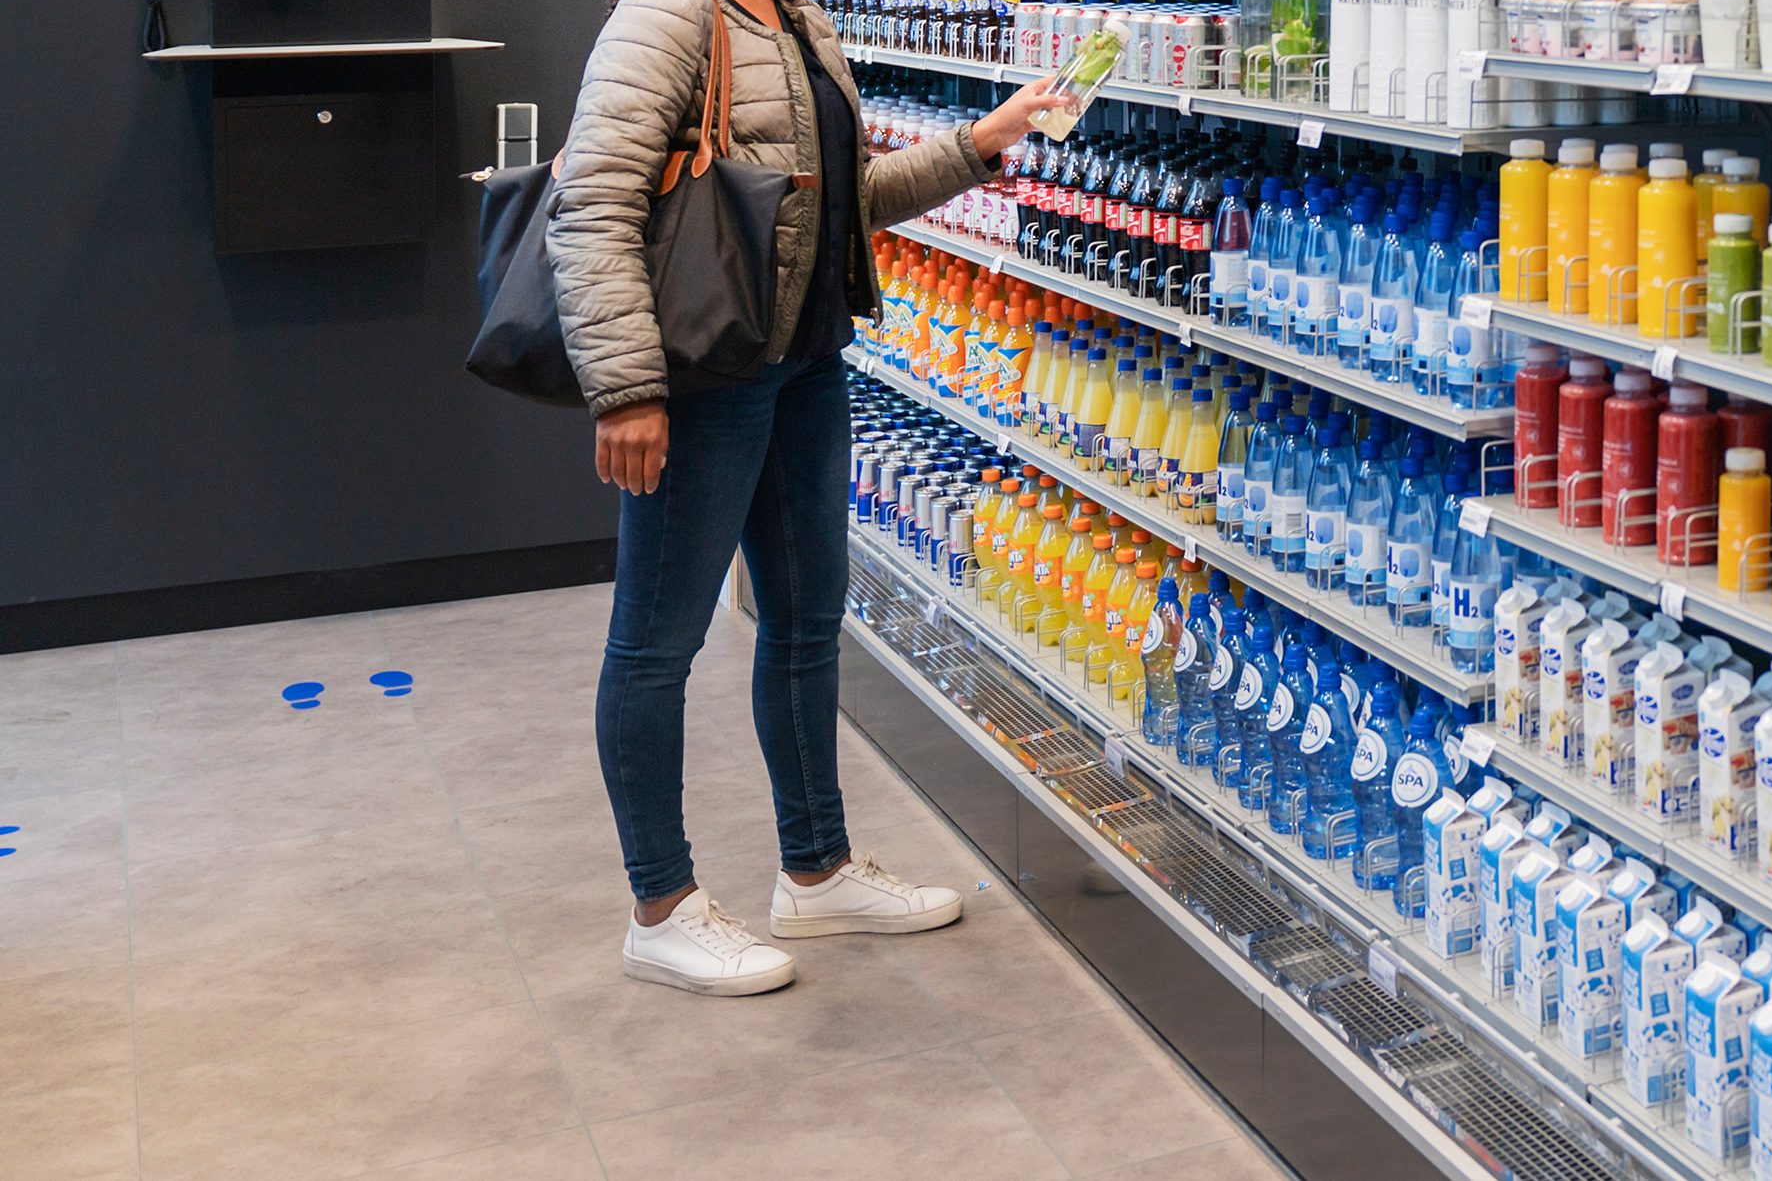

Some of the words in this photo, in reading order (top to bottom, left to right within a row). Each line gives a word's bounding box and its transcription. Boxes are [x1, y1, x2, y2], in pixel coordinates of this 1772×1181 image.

[1454, 587, 1479, 618] H2
[1354, 746, 1374, 762] SPA
[1397, 773, 1424, 789] SPA
